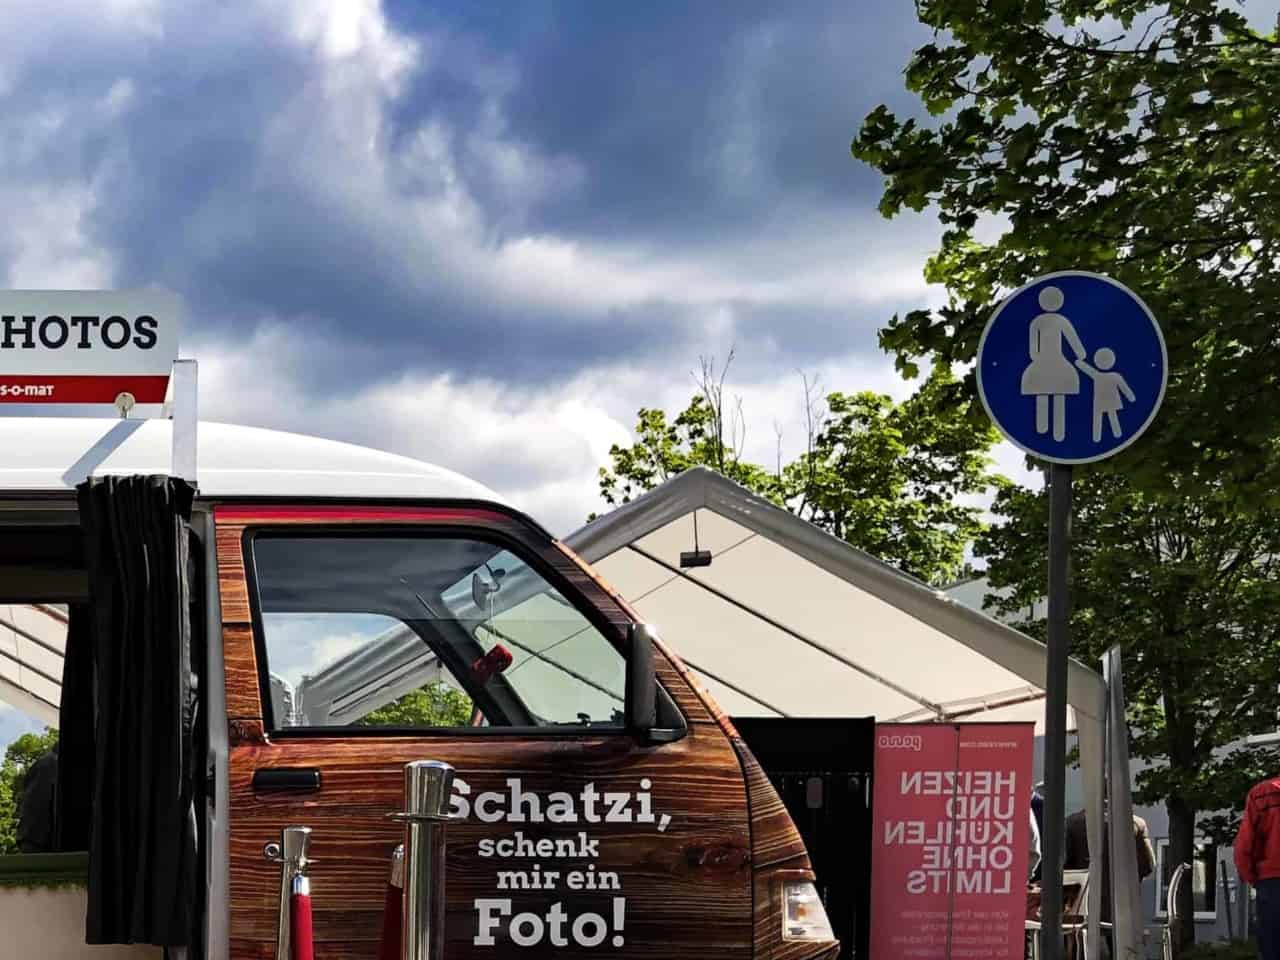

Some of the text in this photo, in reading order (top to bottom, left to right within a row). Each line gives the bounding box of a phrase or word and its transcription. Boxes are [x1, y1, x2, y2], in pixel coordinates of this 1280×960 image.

[448, 778, 672, 832] Schatzi,
[478, 832, 599, 857] schenk
[497, 864, 620, 889] mir ein
[474, 897, 626, 948] Foto!
